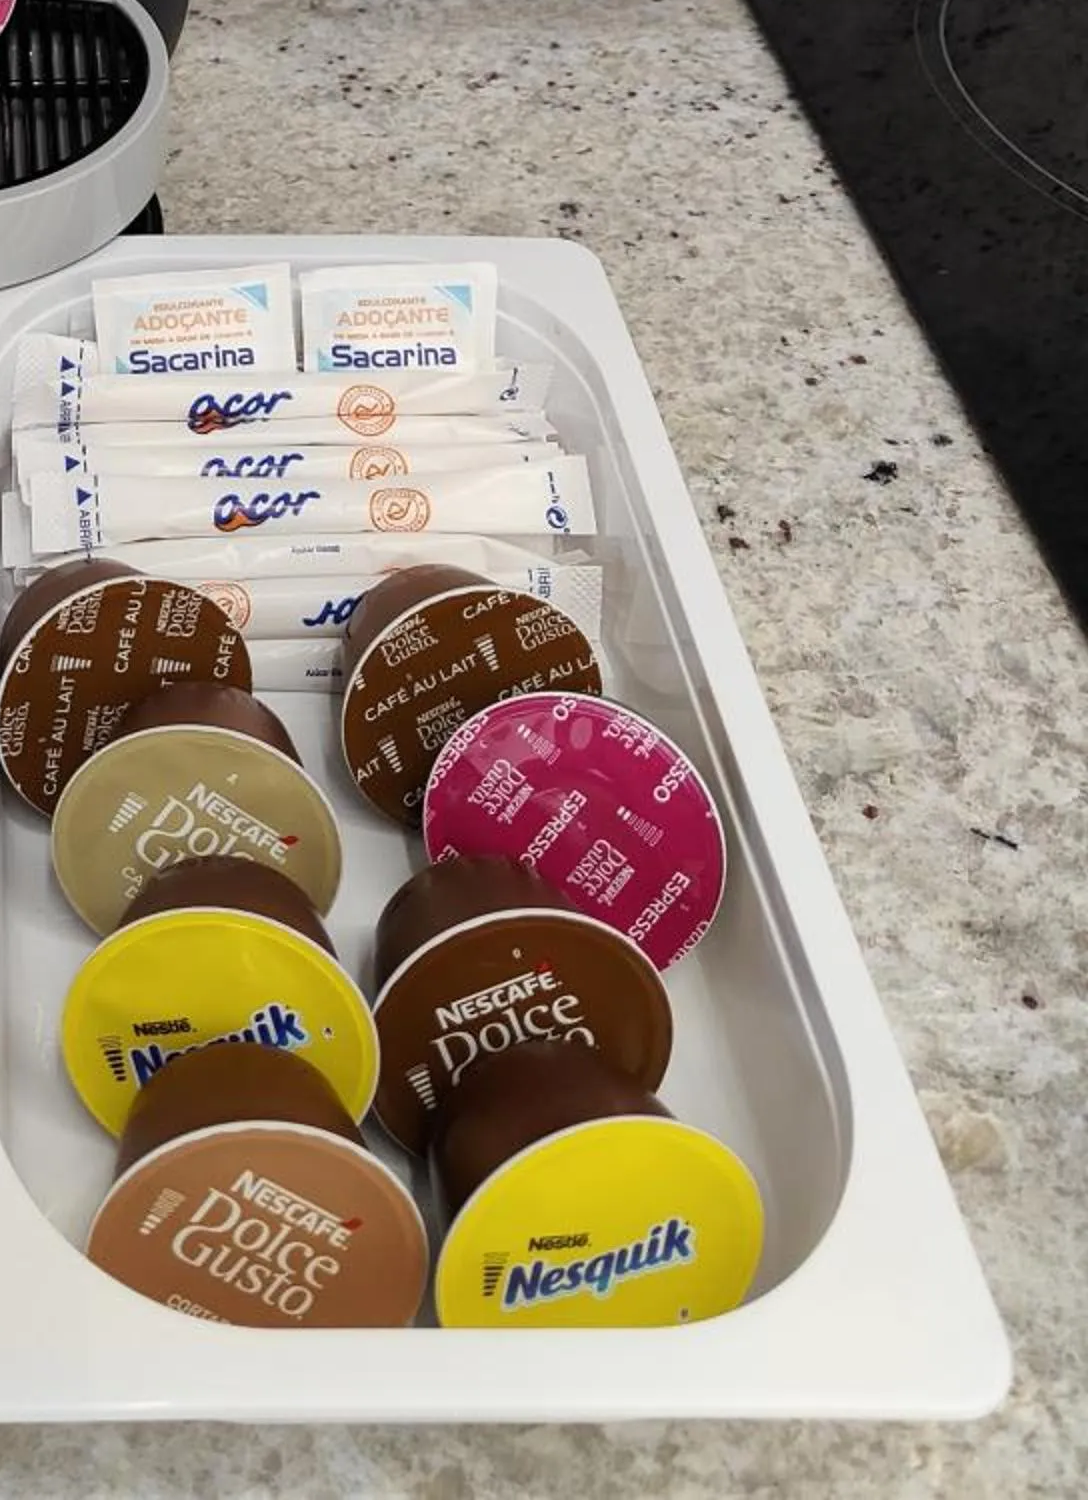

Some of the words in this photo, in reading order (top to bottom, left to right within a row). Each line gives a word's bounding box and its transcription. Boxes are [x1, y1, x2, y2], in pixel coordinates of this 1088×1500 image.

[134, 309, 248, 332] ADOÇANTE
[337, 307, 448, 328] ADOÇANTE
[129, 344, 254, 374] Sacarina
[331, 342, 457, 368] Sacarina
[114, 627, 136, 673] CAFÉ
[125, 599, 142, 623] AU
[165, 589, 190, 637] Dolce
[213, 632, 237, 678] CAFÉ
[380, 626, 431, 656] Dolce
[386, 636, 436, 667] Gusto
[56, 675, 76, 713] LAIT
[365, 686, 410, 721] CAFÉ
[414, 673, 437, 697] AU
[439, 653, 477, 682] LAIT
[549, 661, 573, 682] AU
[51, 718, 67, 743] AU
[43, 747, 63, 795] CAFÉ
[481, 766, 527, 815] Dolce
[582, 848, 628, 896] Dolce
[190, 1187, 341, 1290] Dolce
[505, 1219, 690, 1304] Nesquik
[172, 1225, 315, 1318] Gusto
